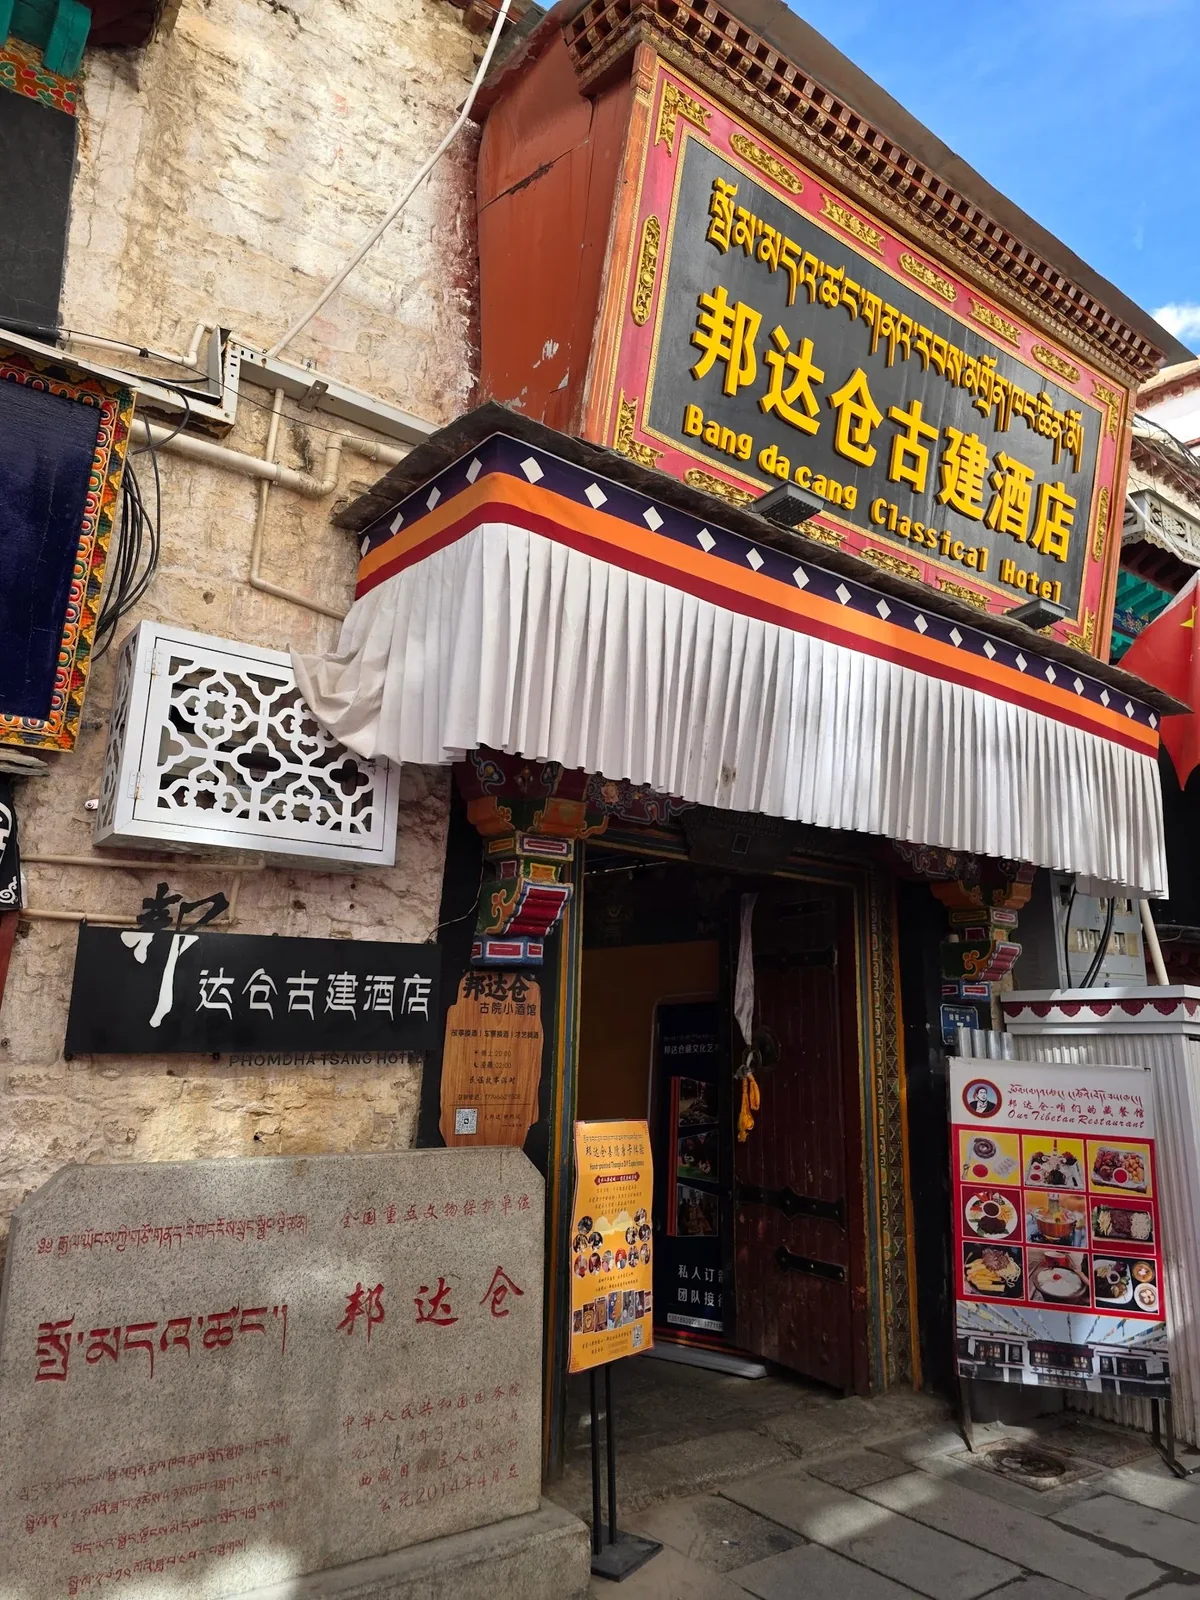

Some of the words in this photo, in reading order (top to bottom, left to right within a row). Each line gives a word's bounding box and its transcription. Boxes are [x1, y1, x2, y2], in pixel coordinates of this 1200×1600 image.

[690, 285, 1077, 562] 邦达仓古建酒店
[683, 404, 753, 460] Bang
[869, 497, 989, 573] Classical
[1001, 559, 1062, 603] Hotel
[121, 882, 432, 1028] 邦达仓古建酒店
[463, 971, 530, 1002] 邦达仓
[480, 1002, 536, 1016] 古院小酒馆
[1008, 1109, 1029, 1119] Our
[1031, 1111, 1075, 1124] Tibetan
[1078, 1115, 1145, 1128] Restaurant
[340, 1194, 530, 1229] 全国重点文物保护单位
[336, 1266, 525, 1343] 邦达仓
